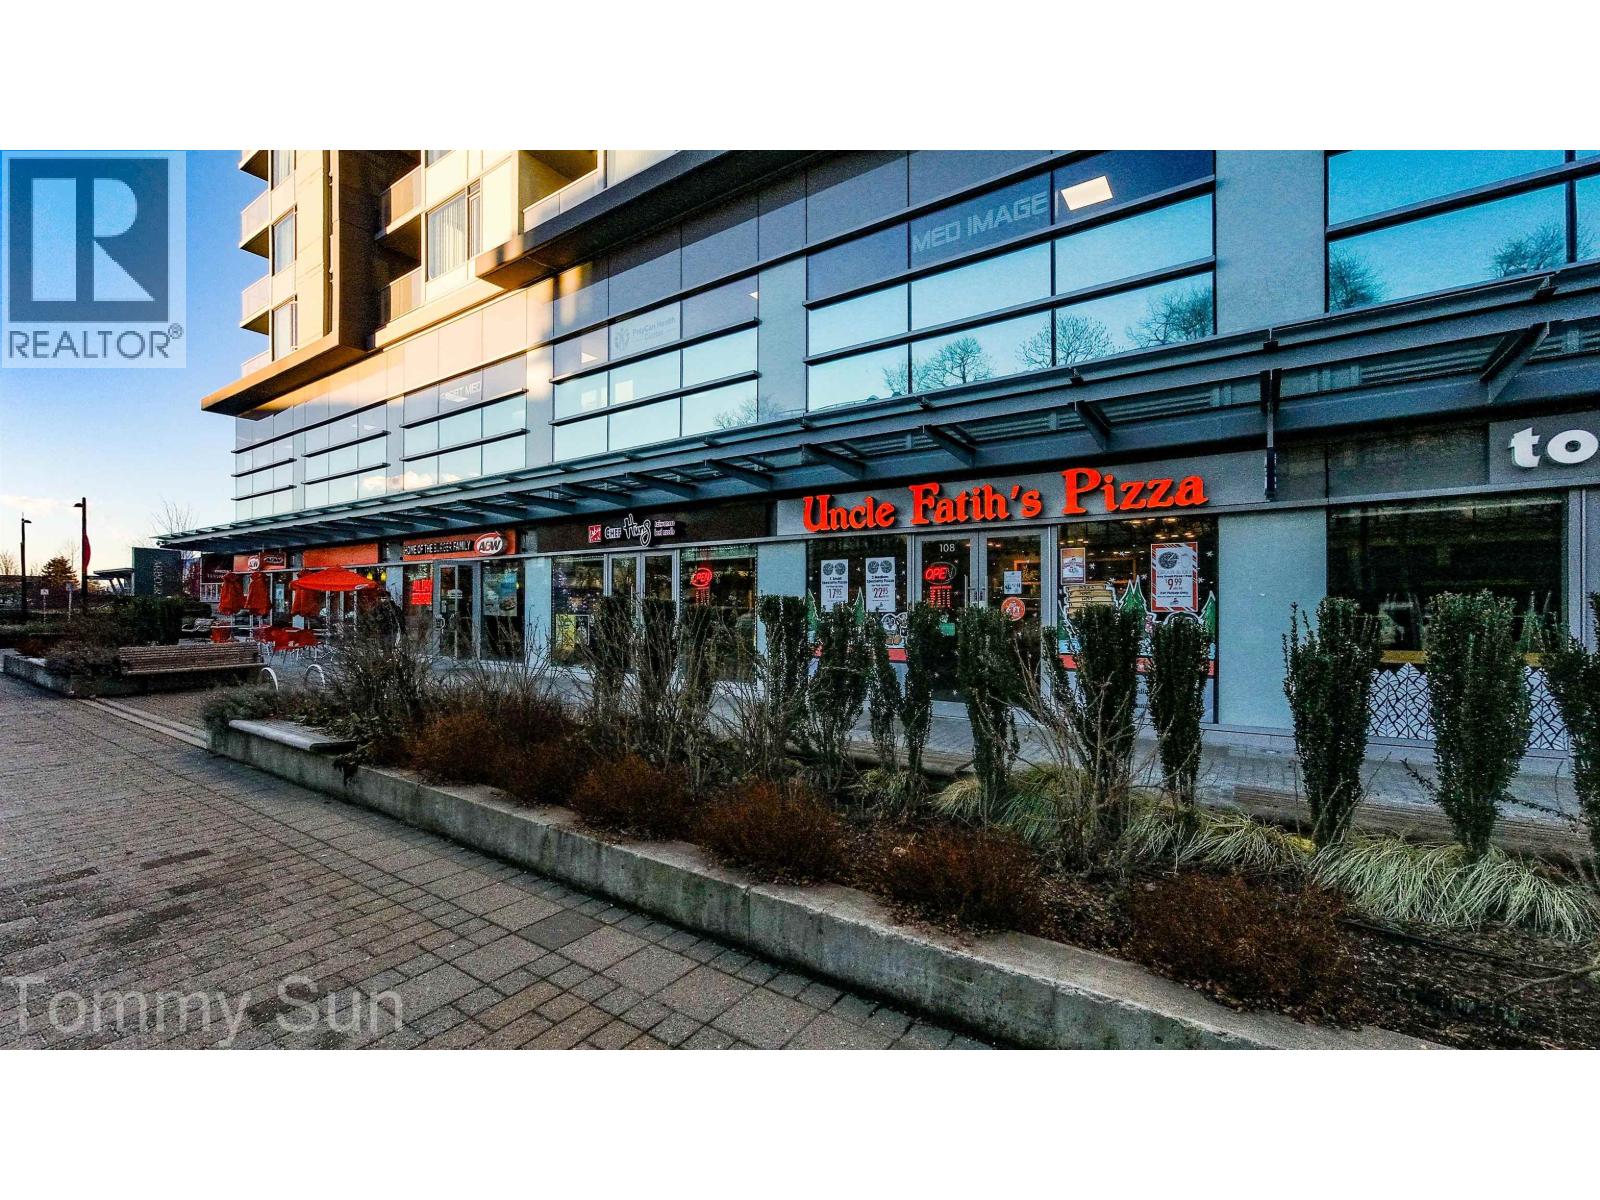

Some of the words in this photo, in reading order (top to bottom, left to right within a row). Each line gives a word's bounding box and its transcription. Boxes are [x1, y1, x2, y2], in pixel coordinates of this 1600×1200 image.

[912, 220, 961, 252] MED
[967, 192, 1048, 238] IMAGE
[1508, 427, 1599, 469] to
[803, 493, 895, 532] Uncle
[908, 482, 1043, 525] Fatih's
[1061, 467, 1208, 515] Pizza
[424, 543, 433, 553] THE
[452, 540, 471, 551] FAMILY
[623, 513, 651, 547] Hung
[939, 544, 955, 552] 108
[925, 567, 952, 581] OPEN
